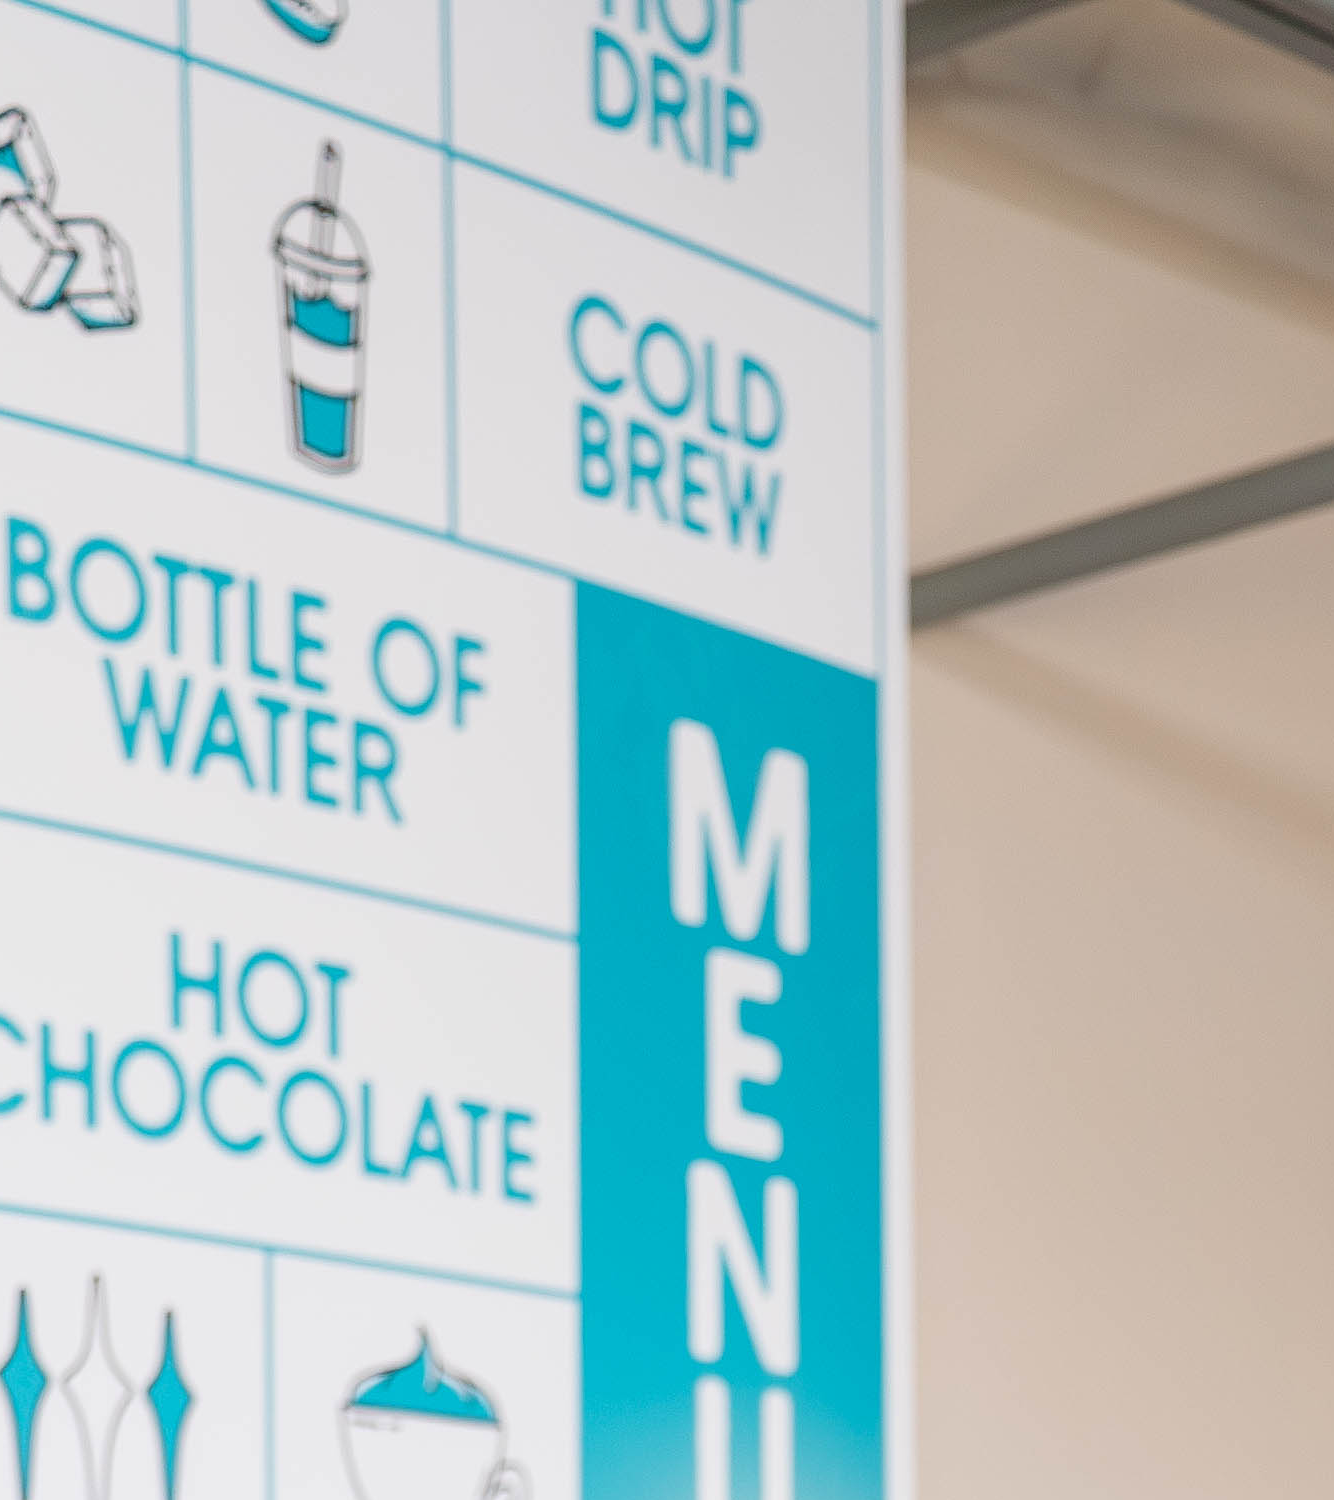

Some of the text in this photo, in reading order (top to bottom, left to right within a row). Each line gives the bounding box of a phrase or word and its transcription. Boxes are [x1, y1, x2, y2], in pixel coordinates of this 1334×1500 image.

[591, 26, 763, 181] DRIP
[601, 0, 753, 75] OT
[568, 293, 784, 455] COLD
[576, 402, 783, 558] BREW
[4, 516, 488, 730] BOTTLE OF
[102, 657, 405, 825] WATER
[169, 929, 354, 1060] HOT
